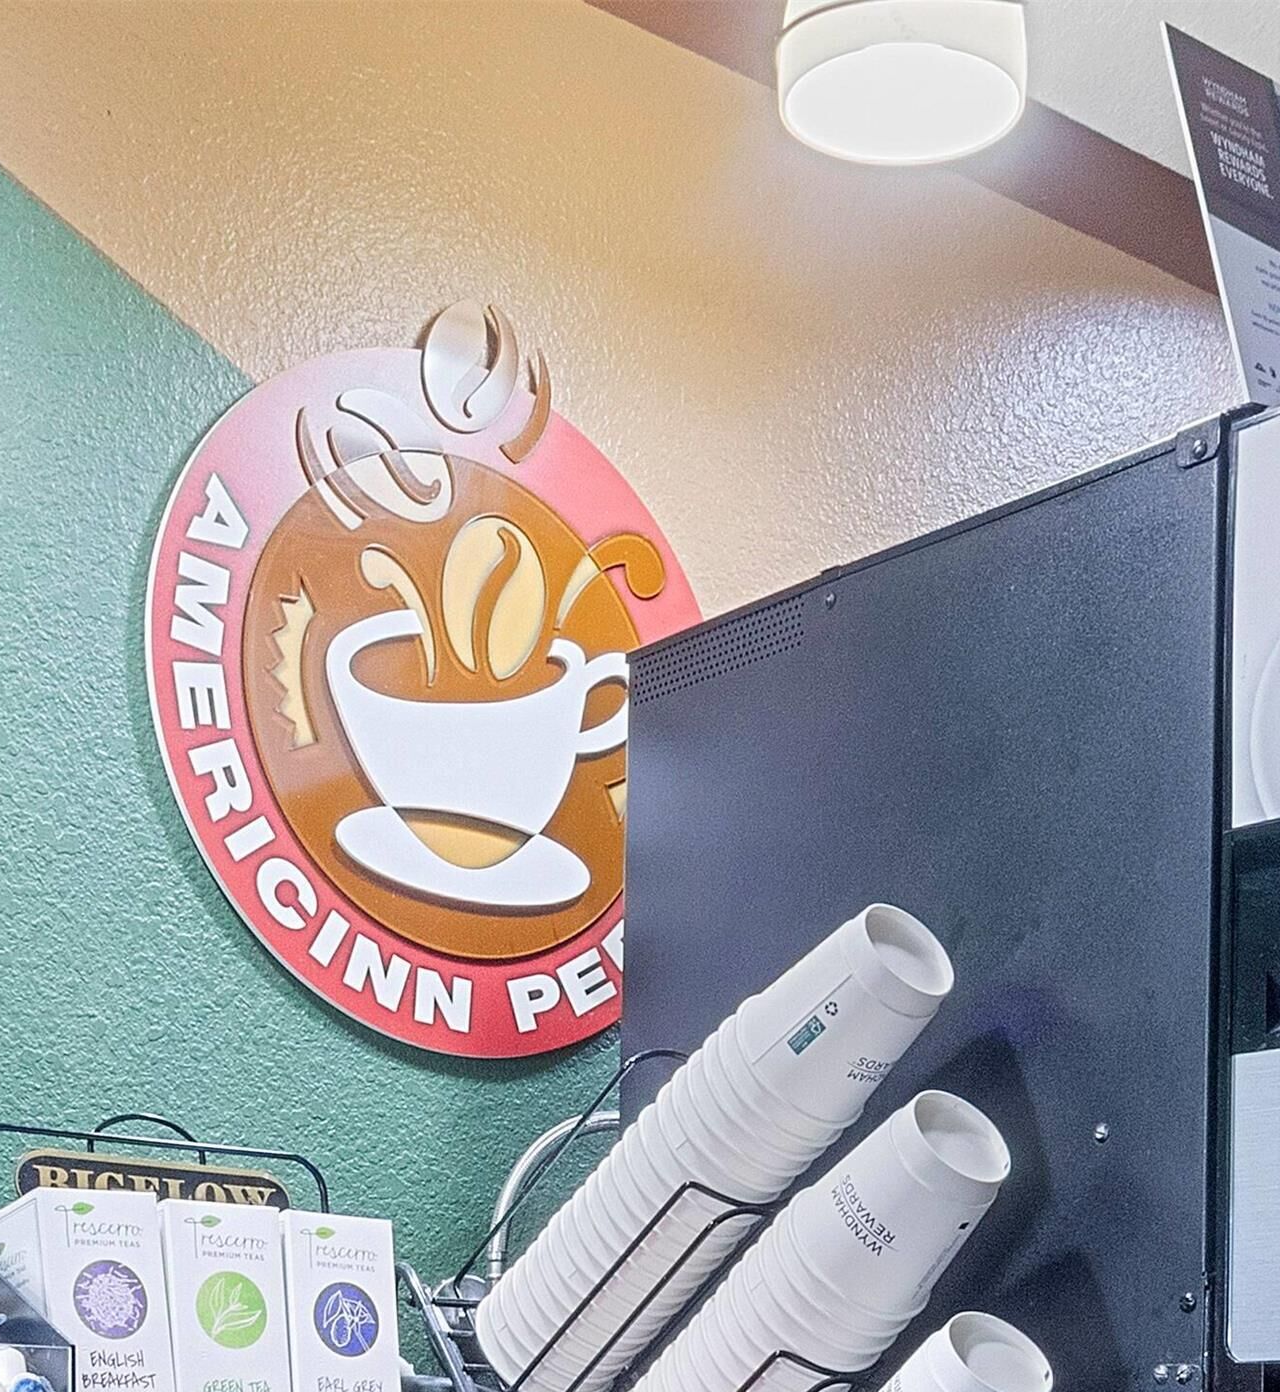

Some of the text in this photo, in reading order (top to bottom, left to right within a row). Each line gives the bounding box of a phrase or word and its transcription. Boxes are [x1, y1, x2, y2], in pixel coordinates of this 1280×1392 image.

[1210, 130, 1265, 168] WYNDHAM
[1218, 147, 1267, 182] REWARDS
[168, 470, 473, 1034] AMERICINN
[842, 1174, 897, 1245] REWARDS
[831, 1185, 883, 1257] WYNDHAM
[74, 1239, 141, 1248] PREMIUM TEAS
[202, 1251, 265, 1262] PREMIUM TEAS
[316, 1261, 376, 1273] PREMIUM TEAS
[90, 1350, 145, 1369] ENGLISH
[82, 1372, 156, 1389] BREAKFAST
[317, 1376, 349, 1392] EARL
